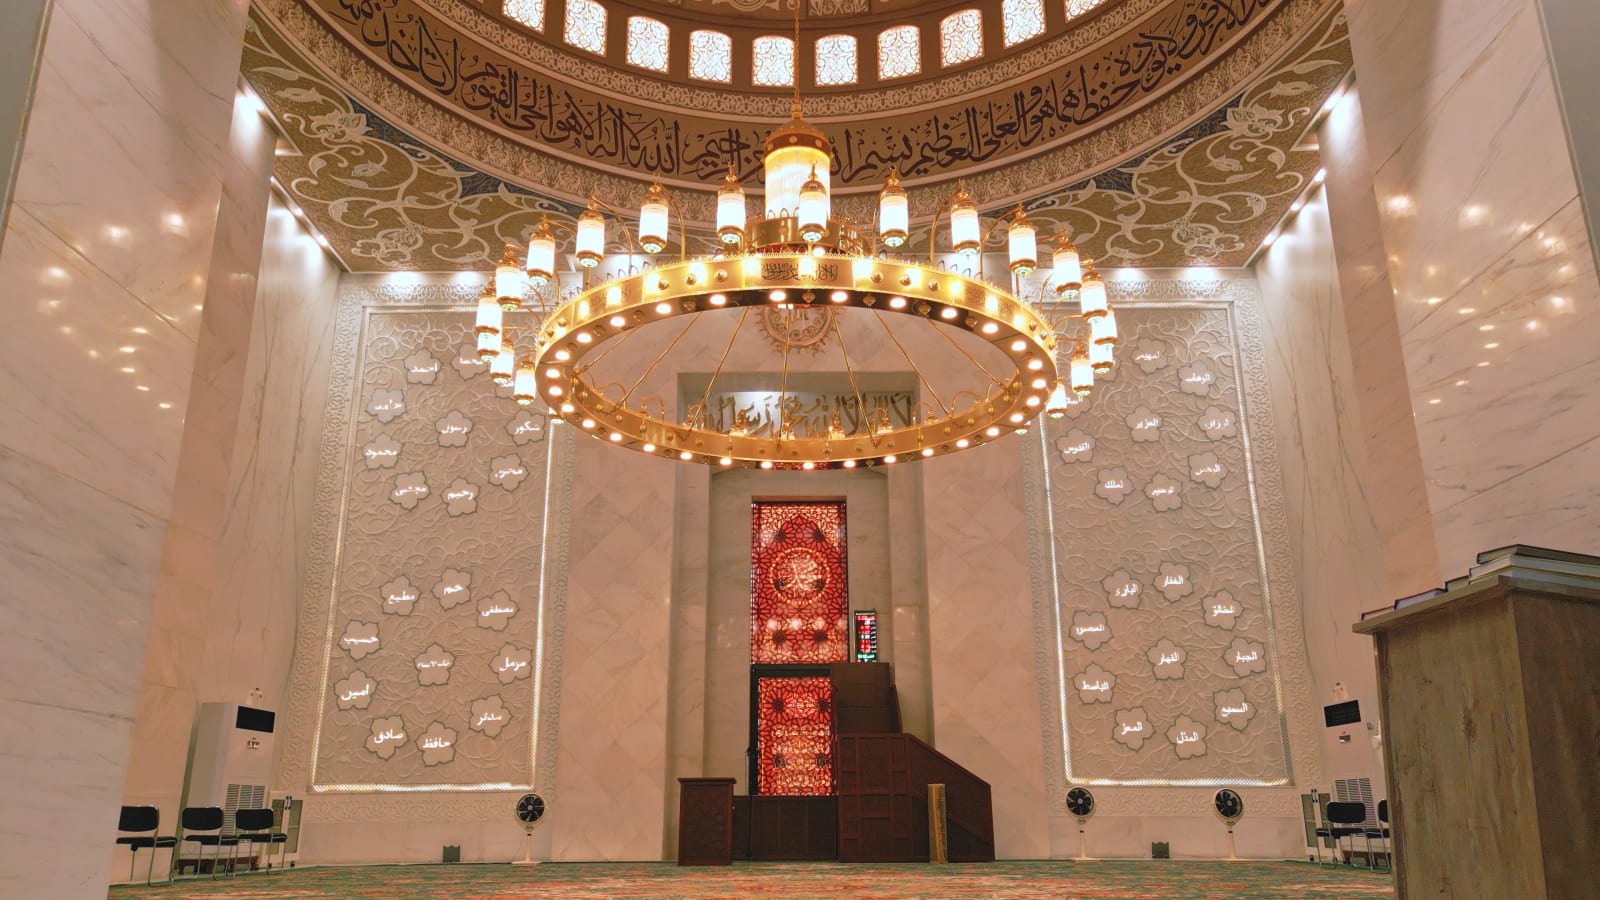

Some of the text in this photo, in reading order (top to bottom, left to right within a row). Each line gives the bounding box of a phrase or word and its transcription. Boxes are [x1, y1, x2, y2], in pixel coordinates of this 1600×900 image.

[441, 421, 468, 435] رسول
[365, 448, 398, 459] محمود
[447, 490, 474, 501] رحيم
[499, 656, 527, 672] مزمل
[373, 728, 404, 744] صادق
[422, 736, 451, 749] حافظ
